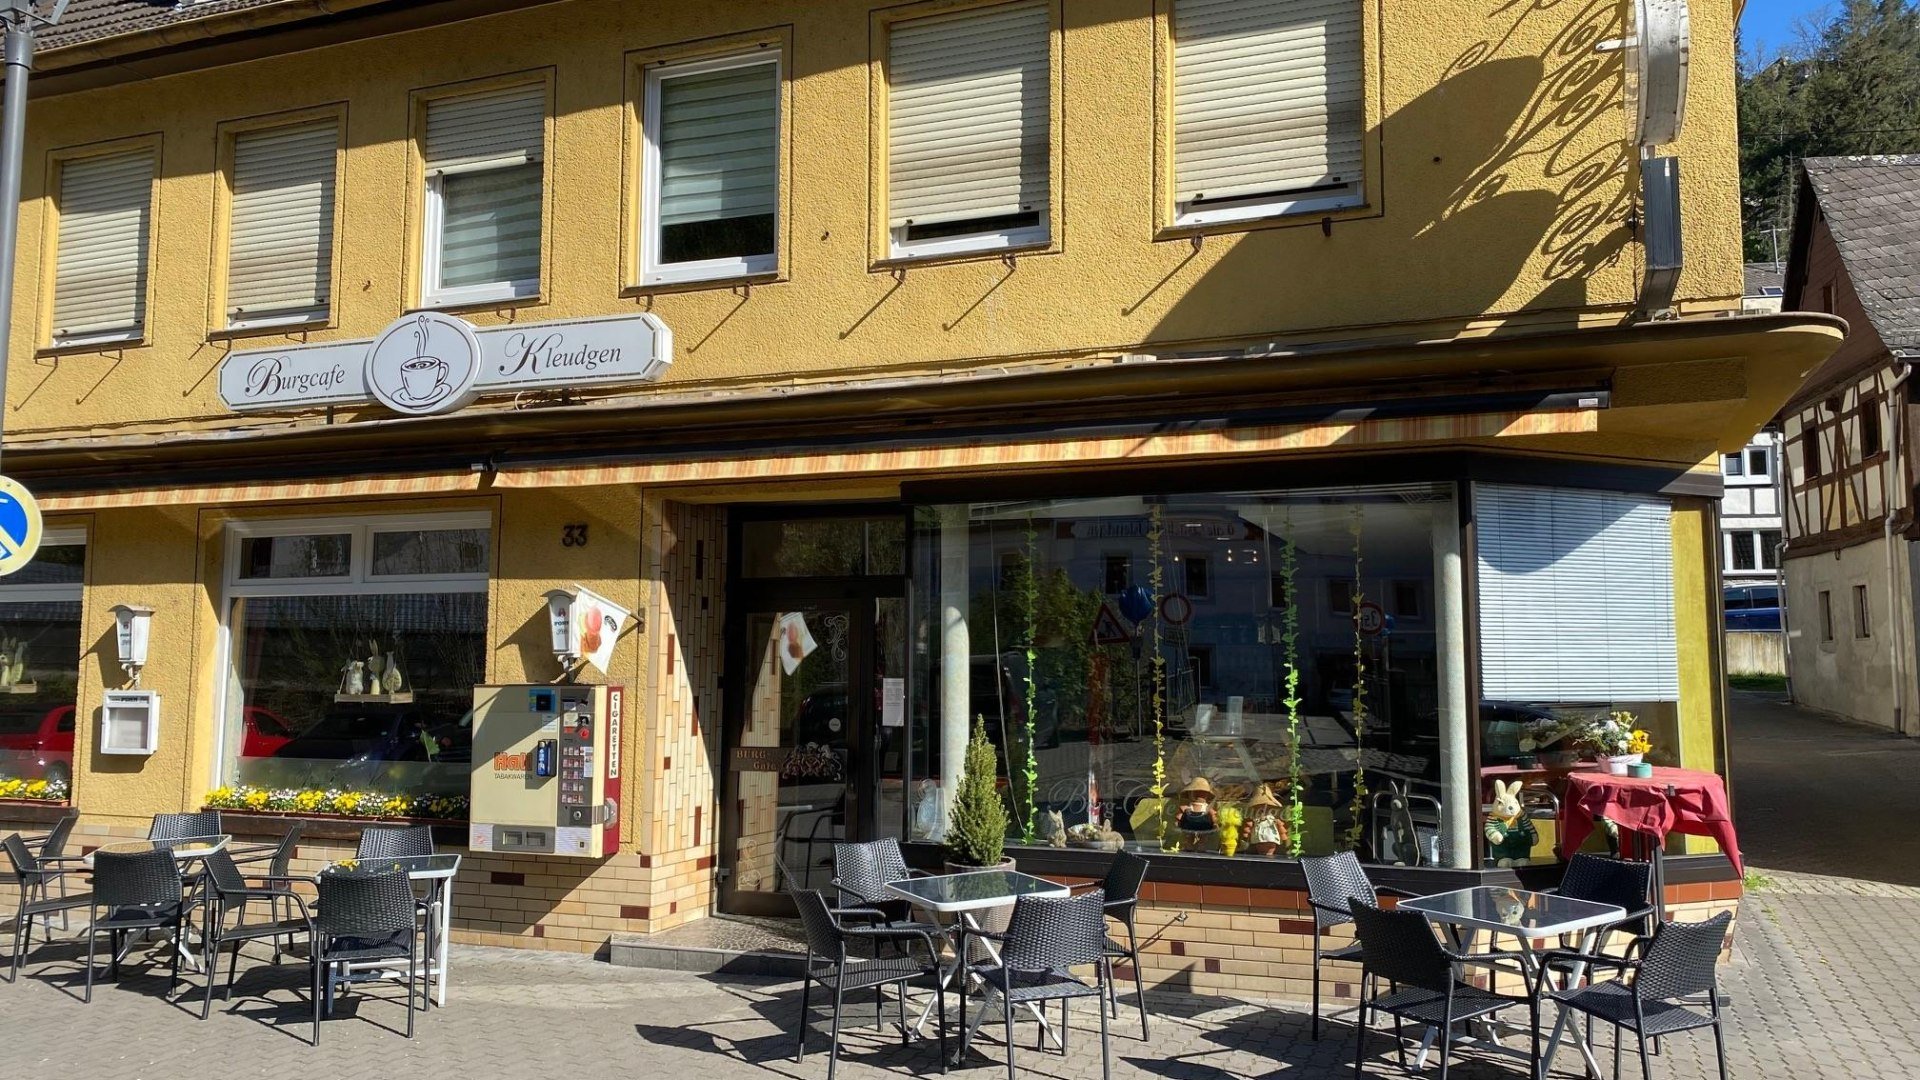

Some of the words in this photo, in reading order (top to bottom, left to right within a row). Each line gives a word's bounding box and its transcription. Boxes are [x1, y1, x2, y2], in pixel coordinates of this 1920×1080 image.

[244, 355, 345, 398] Burgcafe
[498, 332, 621, 377] Kleudgen
[562, 524, 588, 547] 33
[610, 694, 619, 776] CIGARETTEN
[1047, 778, 1176, 819] Brg-Ce
